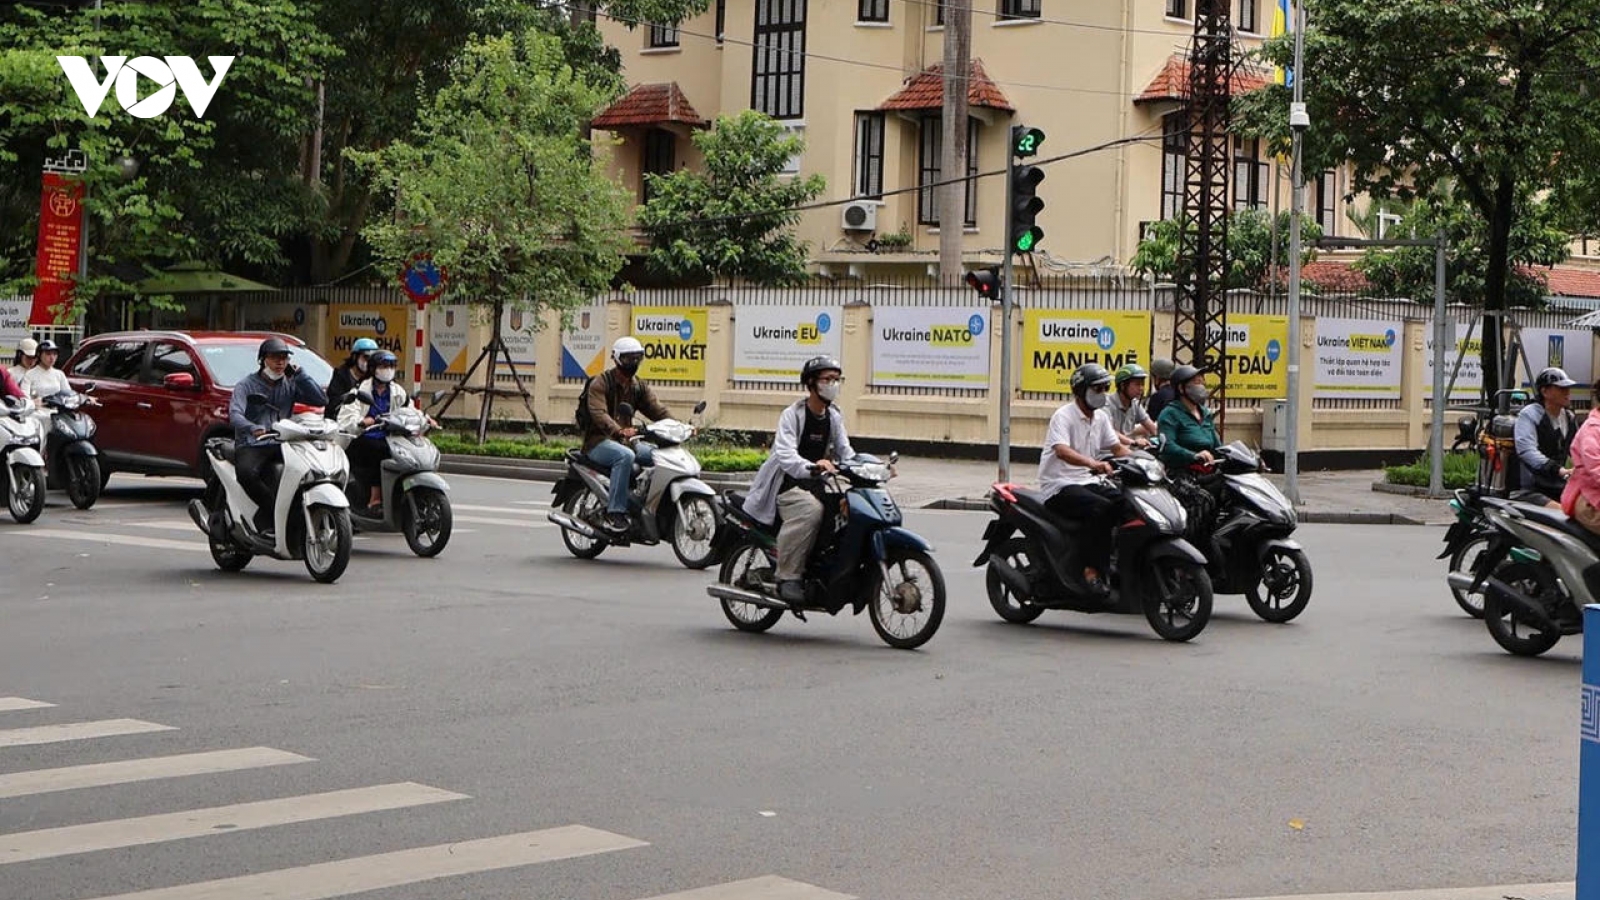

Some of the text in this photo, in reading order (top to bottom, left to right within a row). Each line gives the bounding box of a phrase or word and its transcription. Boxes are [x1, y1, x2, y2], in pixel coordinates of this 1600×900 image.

[637, 319, 681, 331] Ukraine
[1042, 322, 1099, 338] Ukraine
[753, 326, 818, 340] Ukraine EU
[883, 327, 972, 342] Ukraine NATO
[1317, 336, 1350, 347] Ukraine
[644, 339, 676, 359] OÀN
